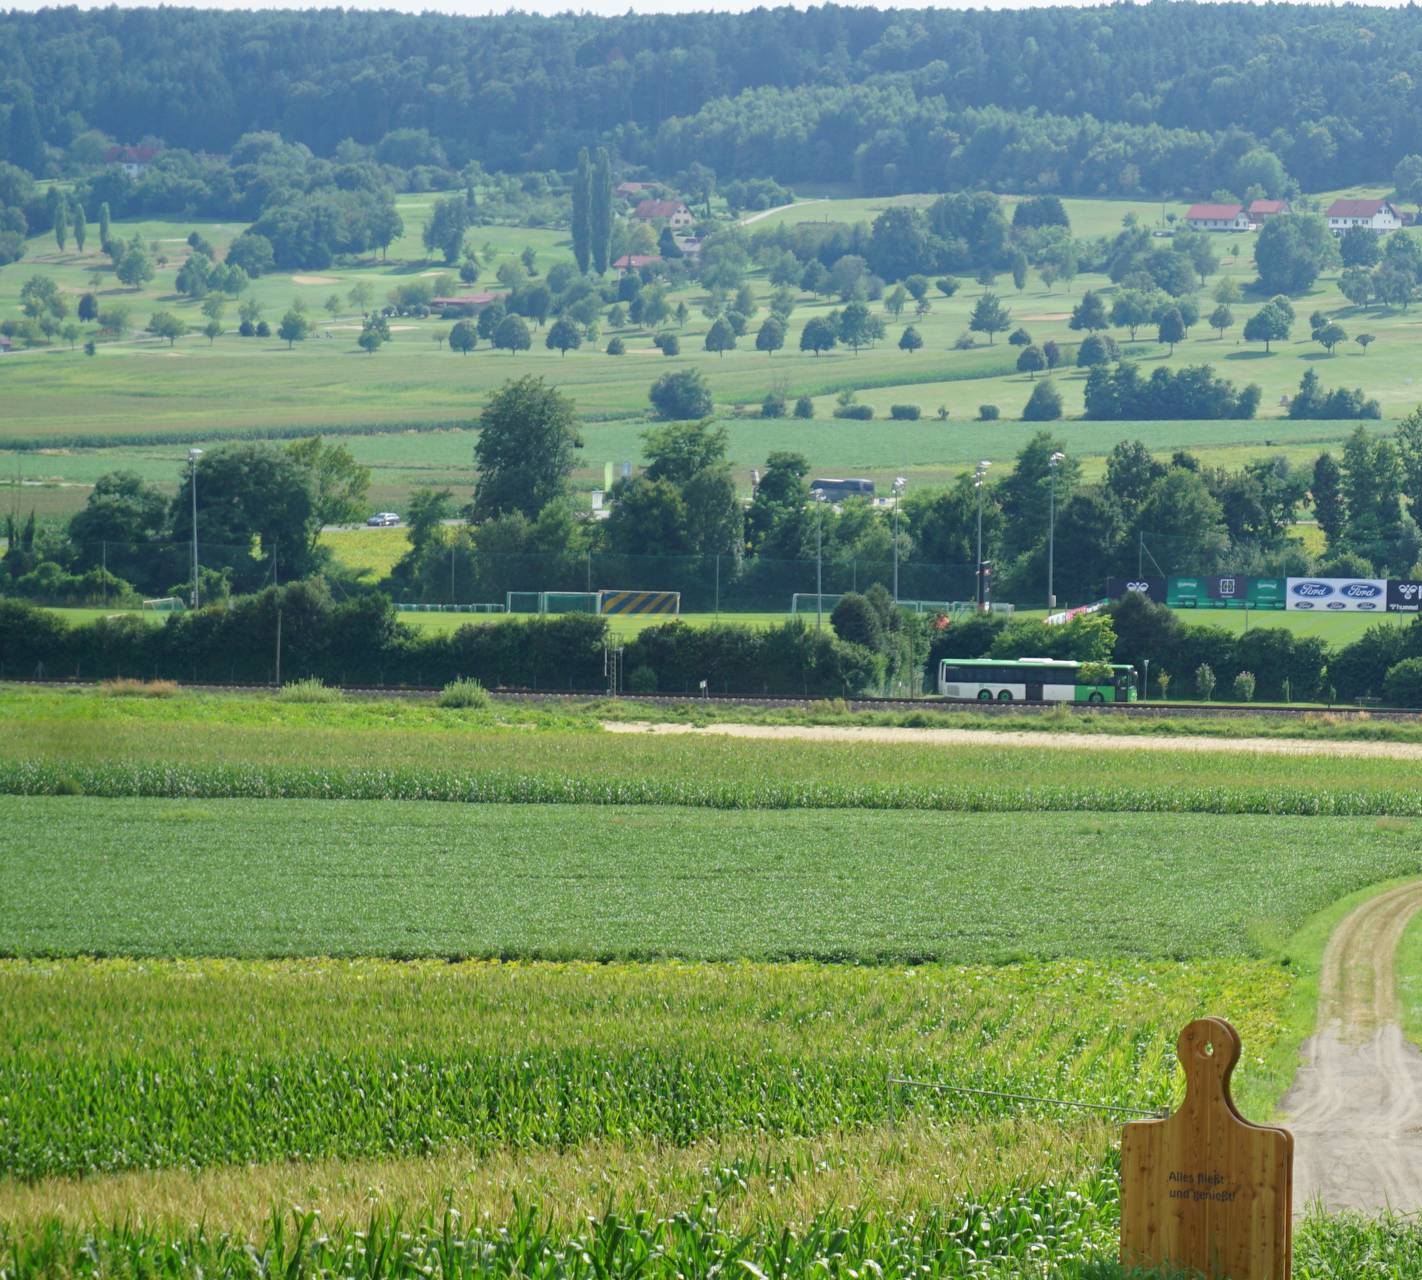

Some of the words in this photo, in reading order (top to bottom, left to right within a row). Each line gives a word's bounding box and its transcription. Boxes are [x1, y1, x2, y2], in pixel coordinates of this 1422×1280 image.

[1300, 584, 1326, 596] Ford
[1347, 584, 1374, 597] Ford
[1169, 1171, 1194, 1183] Alles
[1169, 1188, 1190, 1199] und
